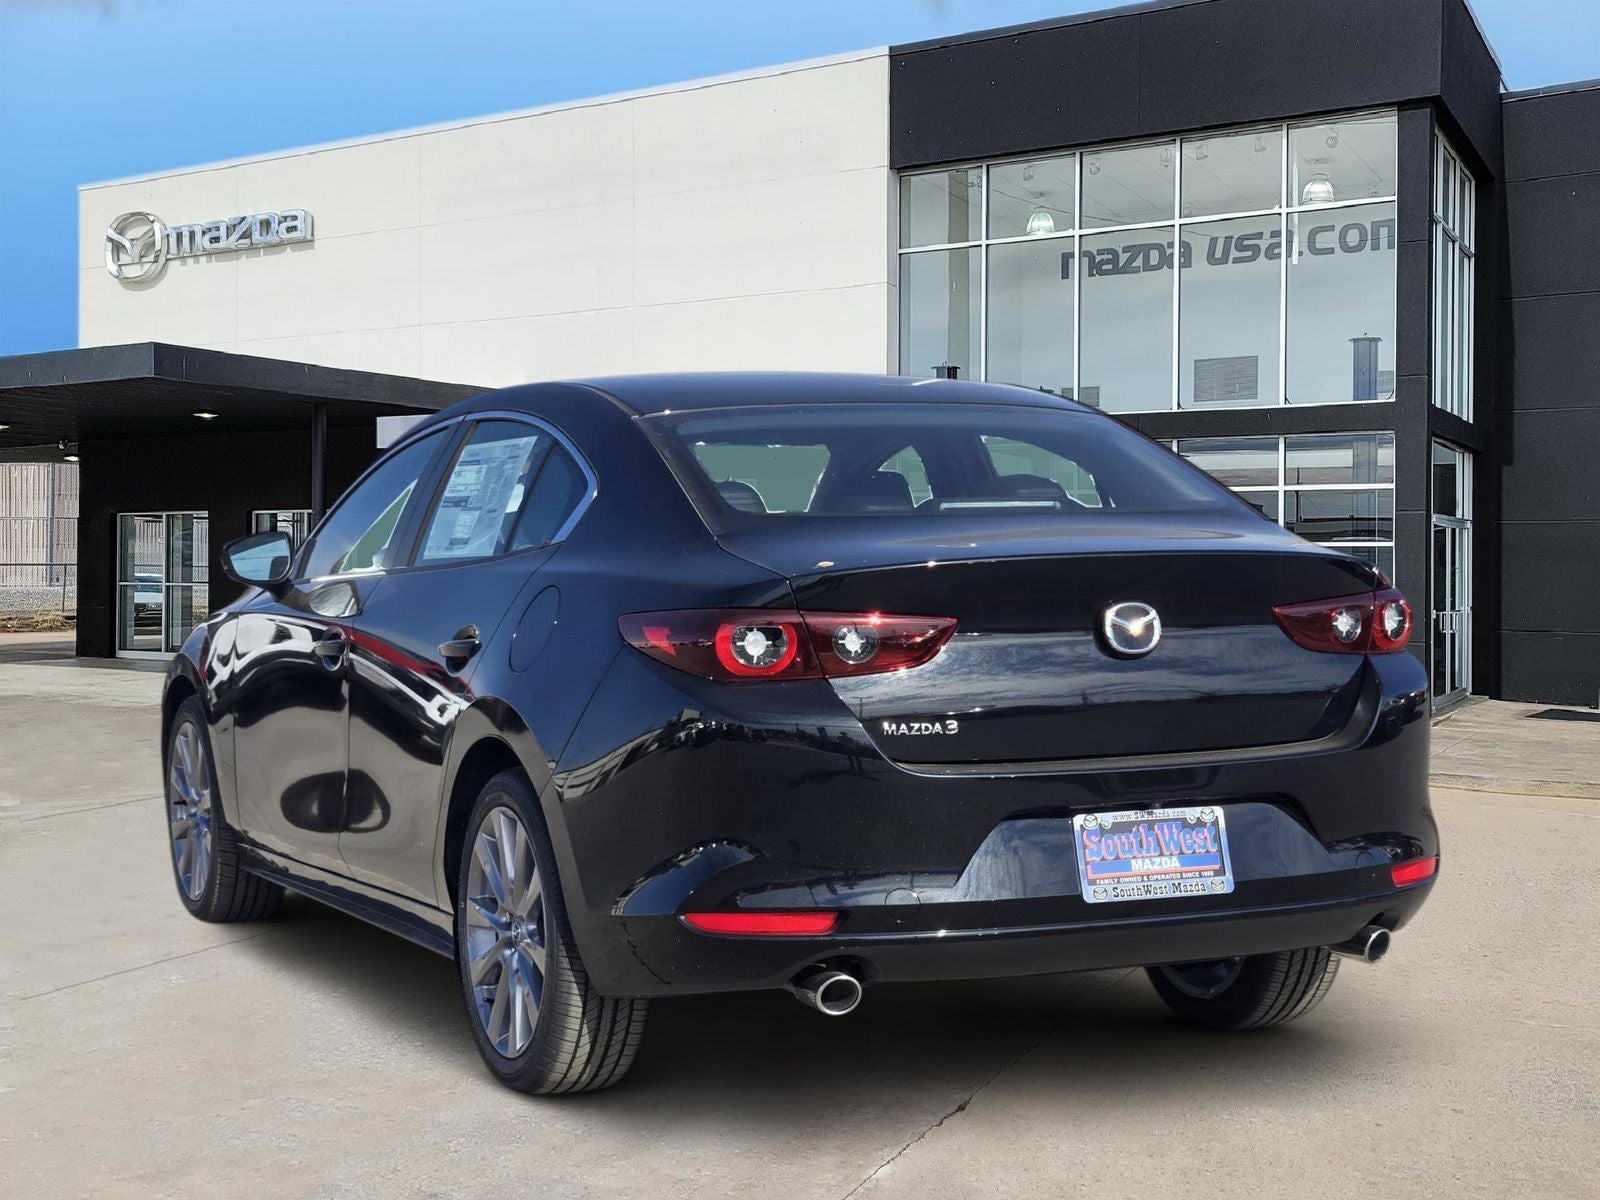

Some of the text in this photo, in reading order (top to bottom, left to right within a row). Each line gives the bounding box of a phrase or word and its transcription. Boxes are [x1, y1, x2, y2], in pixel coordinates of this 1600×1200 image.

[167, 209, 311, 256] mazda
[1061, 240, 1192, 280] mazda
[1131, 856, 1181, 871] MAZDA
[1120, 876, 1142, 884] OWNED
[1149, 872, 1181, 880] OPERATED
[1182, 871, 1200, 879] SINCE
[1112, 882, 1207, 898] SouthWest Mazda
